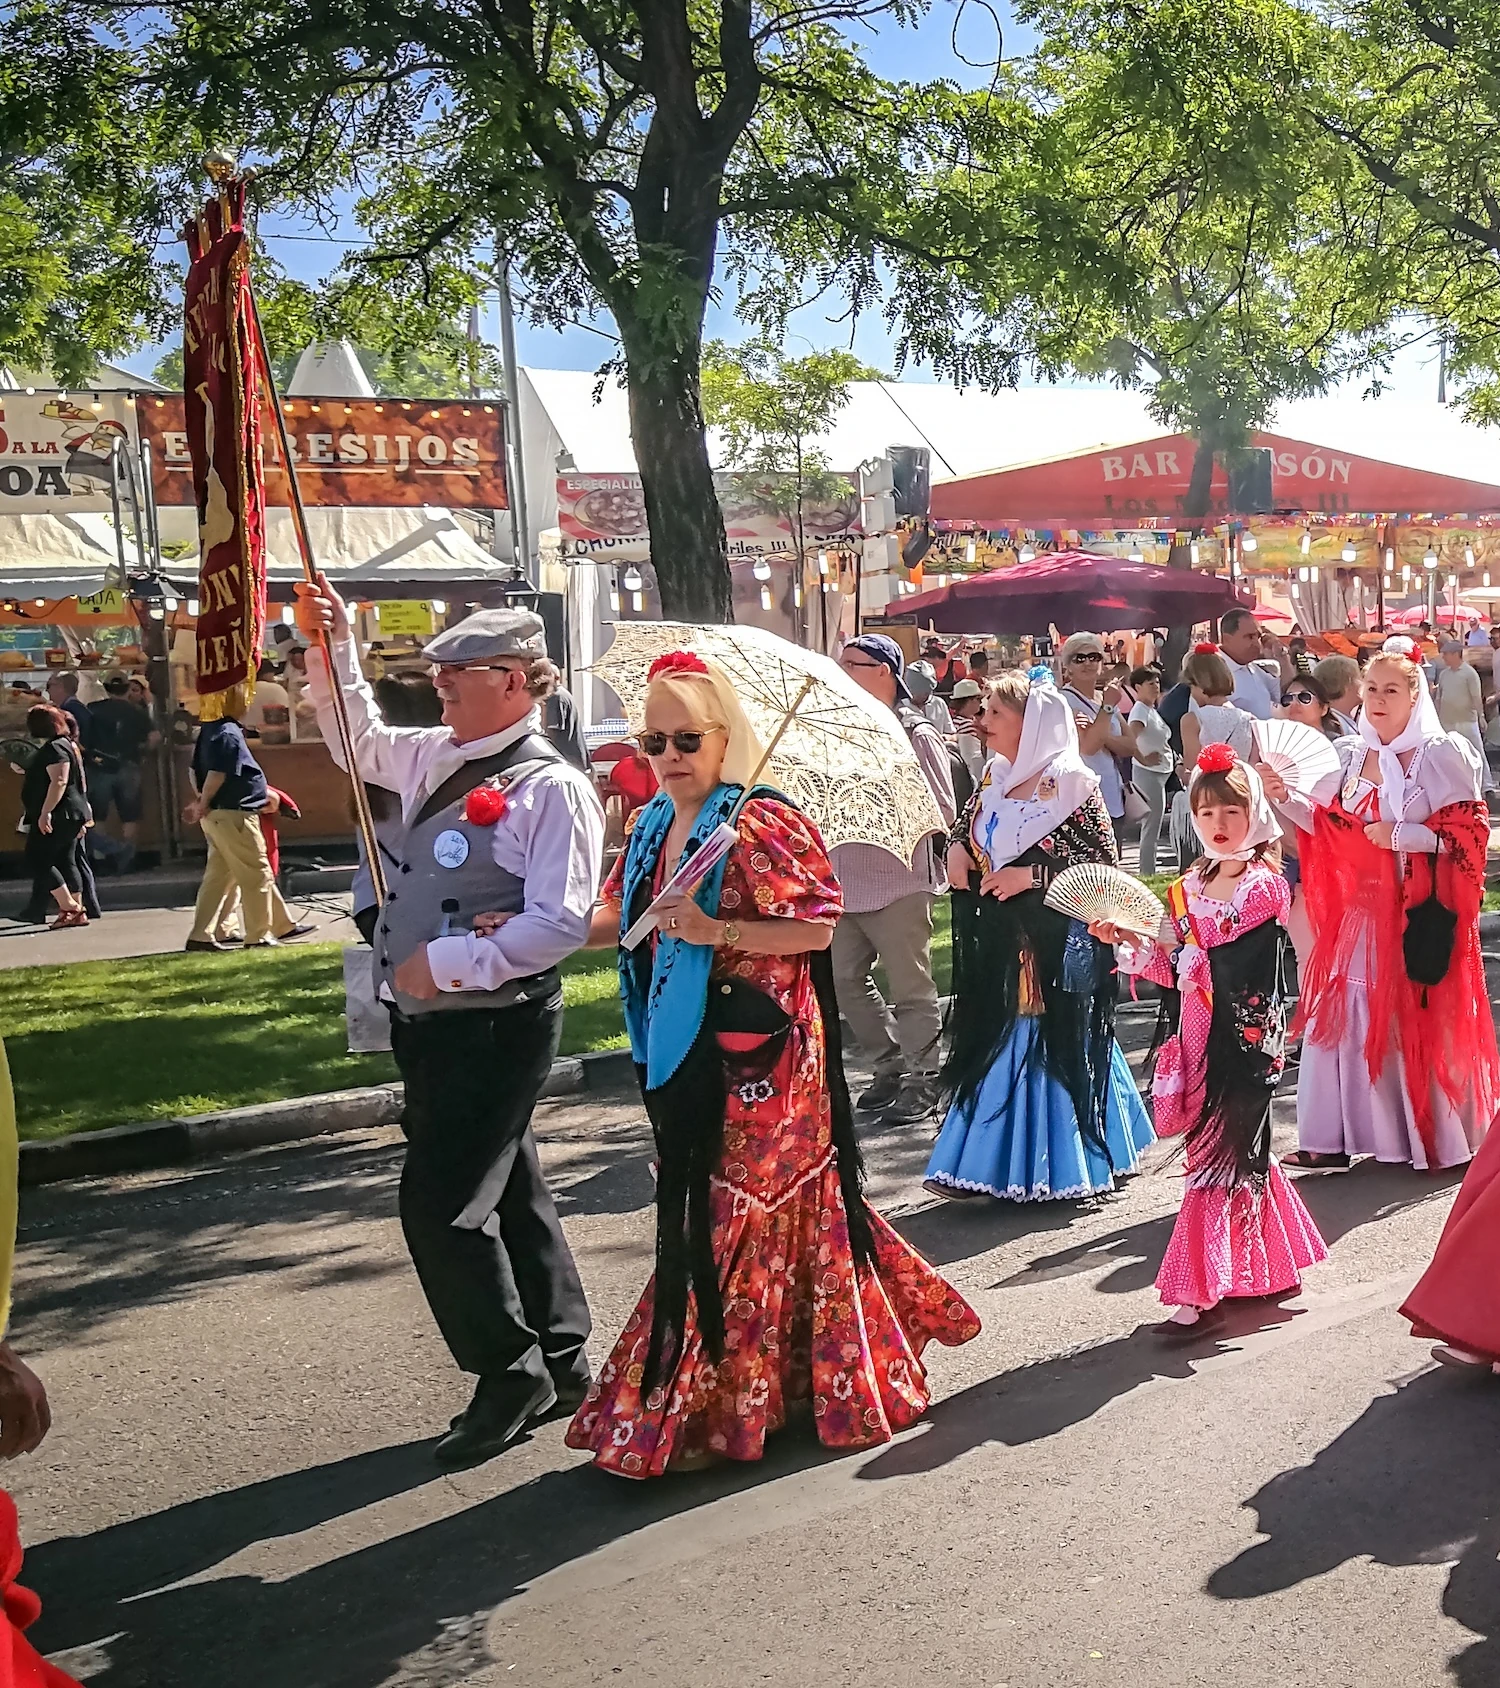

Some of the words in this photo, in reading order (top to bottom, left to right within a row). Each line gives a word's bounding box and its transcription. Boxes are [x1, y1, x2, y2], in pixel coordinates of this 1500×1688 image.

[12, 442, 26, 453] A
[31, 442, 59, 453] LA
[163, 432, 480, 471] ERESIJOS
[1101, 451, 1181, 482] BAR
[567, 479, 642, 490] ESPECIALID
